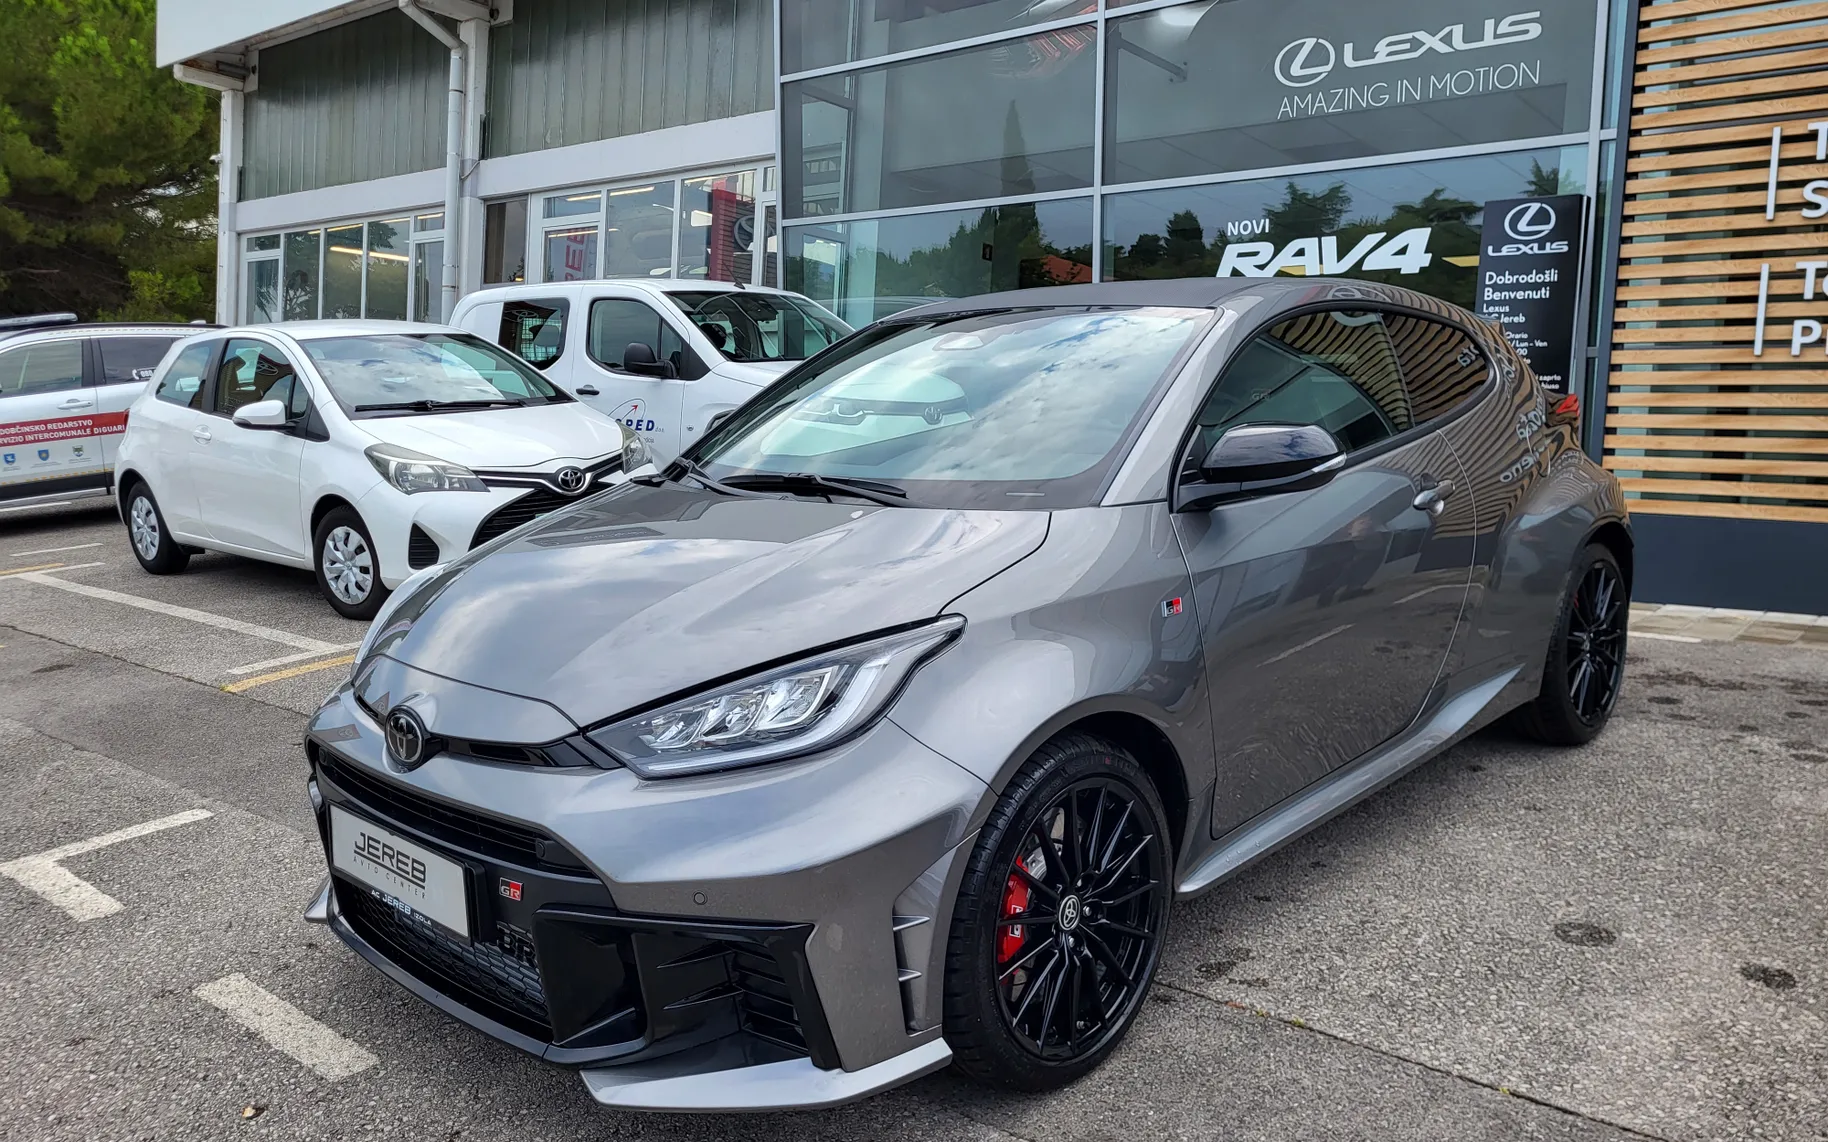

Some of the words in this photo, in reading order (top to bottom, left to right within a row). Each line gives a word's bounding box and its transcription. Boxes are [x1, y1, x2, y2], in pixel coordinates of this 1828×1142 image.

[1343, 10, 1542, 68] LEXUS
[1277, 83, 1390, 120] AMAZING
[1397, 77, 1421, 103] IN
[1429, 60, 1541, 99] MOTION
[1226, 217, 1271, 237] NOVI
[1215, 226, 1433, 278] RAV4
[1487, 241, 1569, 257] LEXUS
[1484, 268, 1559, 286] Dobrodošli
[1483, 286, 1550, 301] Benvenuti
[1482, 302, 1510, 313] Lexus
[1534, 339, 1548, 347] Ven
[47, 419, 93, 431] REDARSTVO
[615, 418, 655, 432] PED
[25, 429, 92, 442] INTERCOMUNALE
[354, 831, 427, 884] JEREB
[353, 855, 379, 874] AVTO
[385, 871, 426, 900] CENTER
[501, 885, 521, 900] GR
[371, 889, 381, 899] AC
[382, 893, 412, 915] JEREB
[413, 911, 432, 926] IZOLA
